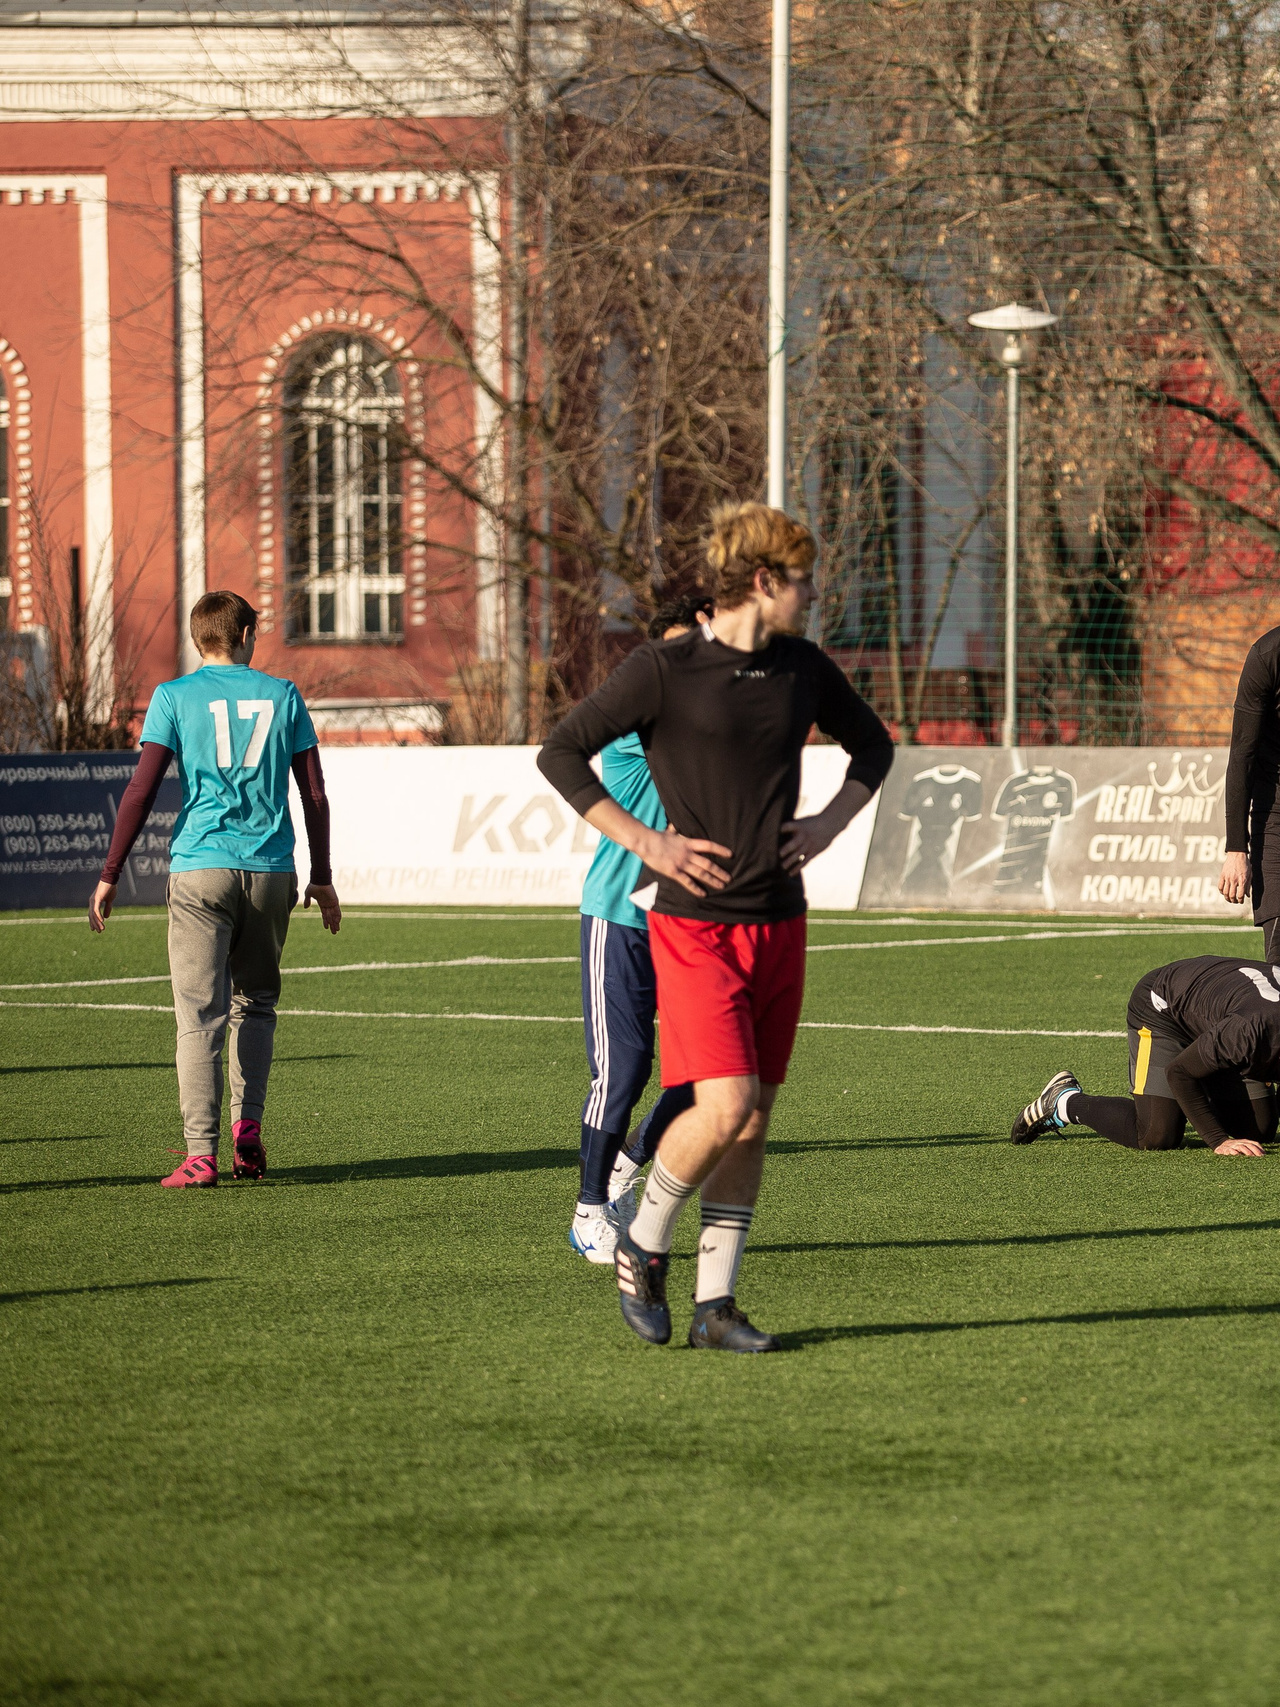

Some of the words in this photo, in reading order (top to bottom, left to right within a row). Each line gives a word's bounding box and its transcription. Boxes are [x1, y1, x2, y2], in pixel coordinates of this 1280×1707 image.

[209, 699, 274, 767] 17
[4, 834, 41, 856] (903)
[43, 833, 110, 851] 263-49-17
[1088, 834, 1178, 863] СТИЛЬ
[1183, 835, 1227, 863] ТВ
[336, 866, 445, 891] БЫСТРОЕ
[452, 866, 571, 891] РЕШЕНИЕ
